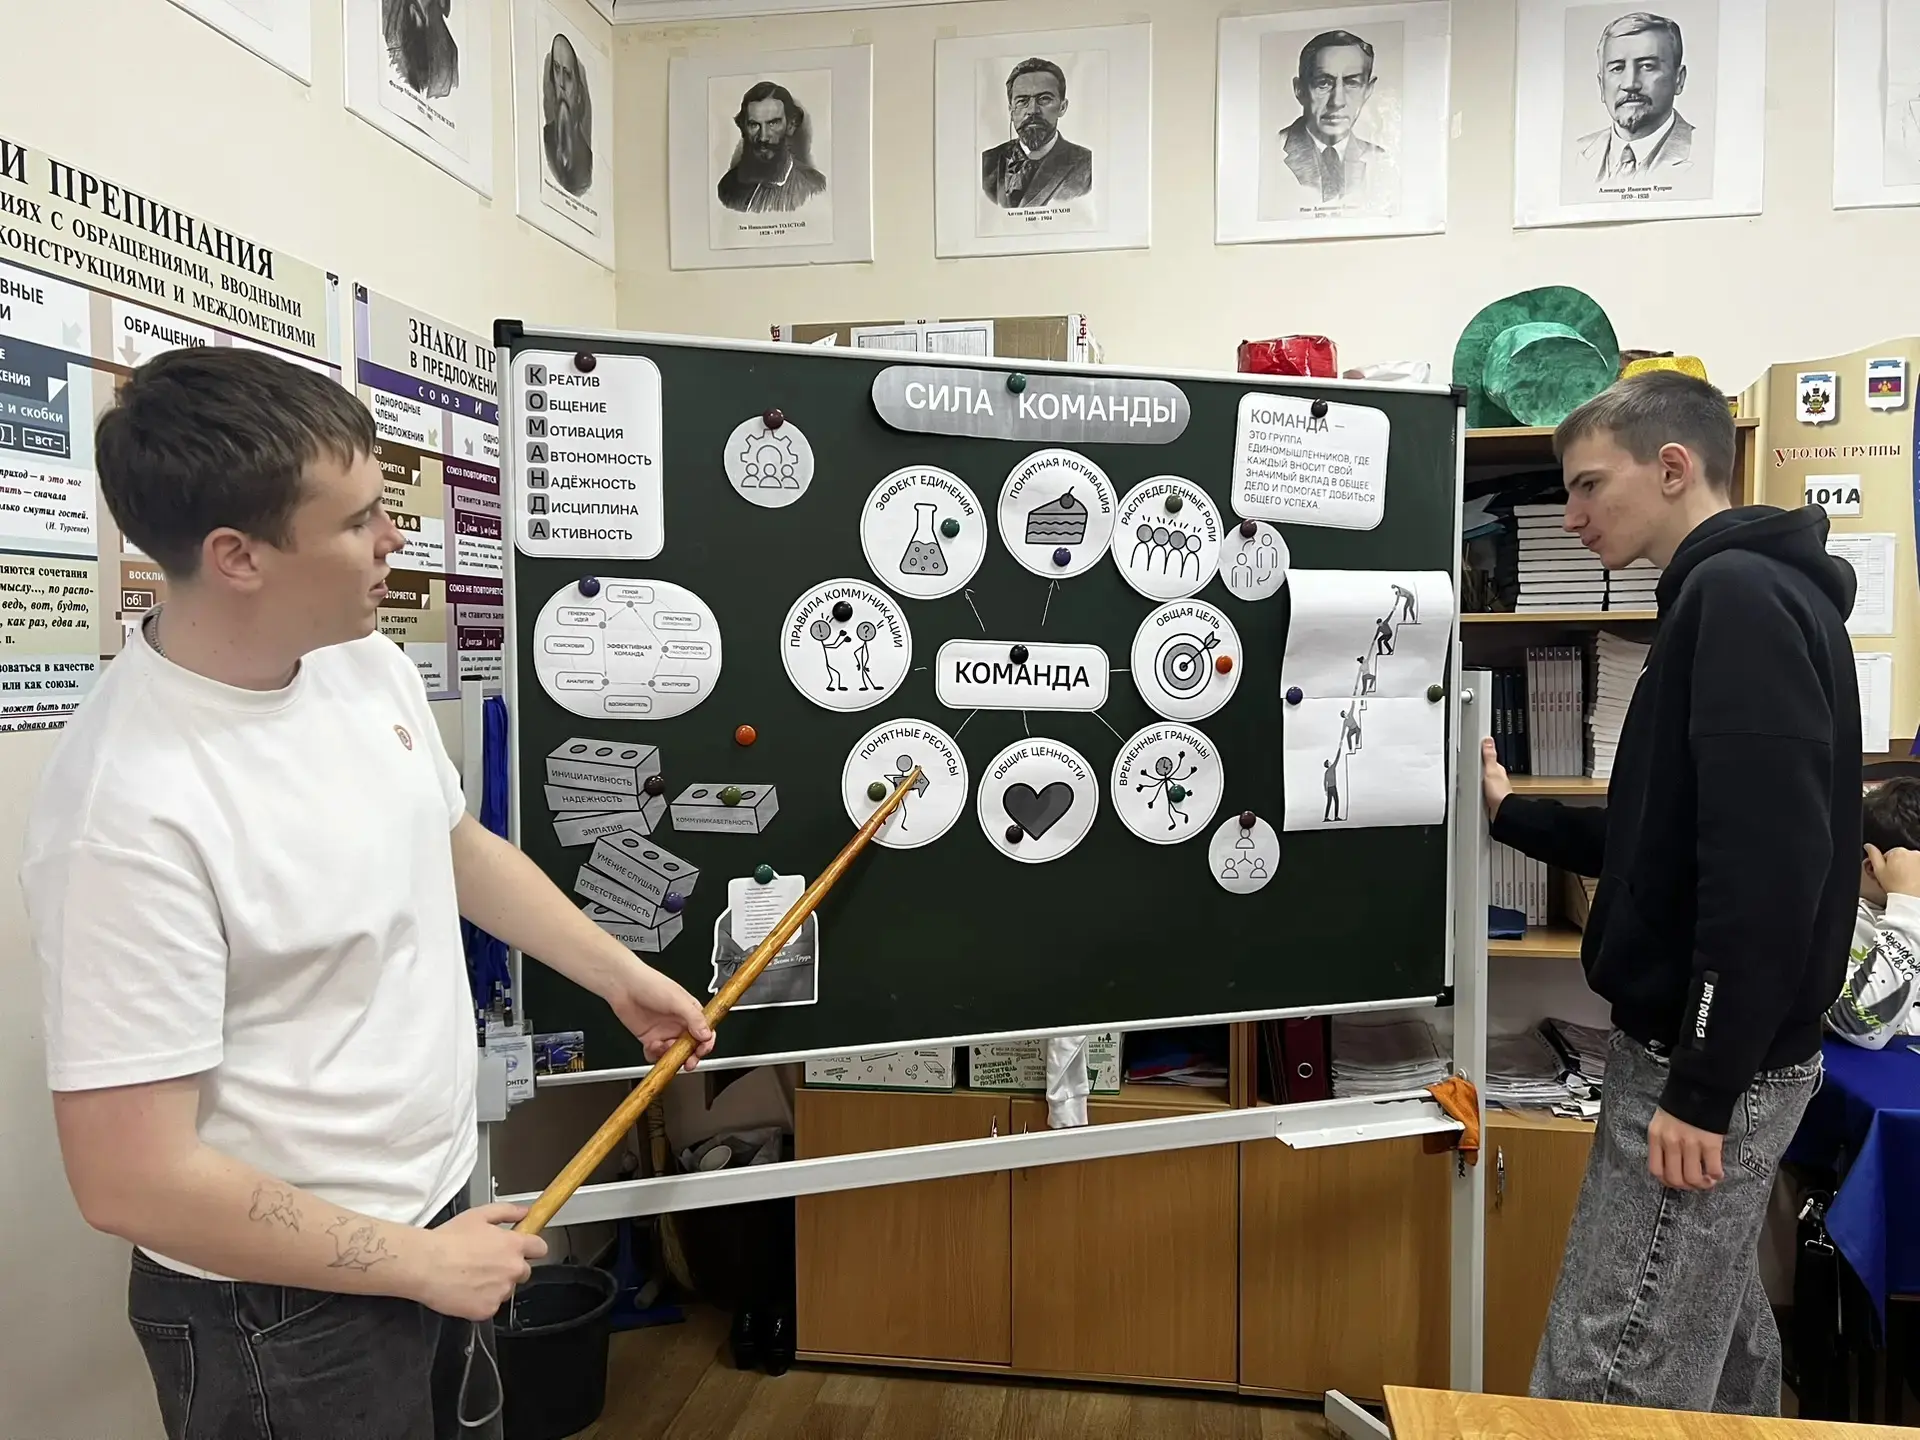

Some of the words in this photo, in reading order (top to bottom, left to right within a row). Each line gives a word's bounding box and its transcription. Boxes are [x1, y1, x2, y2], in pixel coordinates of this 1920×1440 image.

[0, 138, 28, 185] И
[47, 158, 274, 281] ПРЕПИНАНИЯ
[51, 211, 64, 230] С
[72, 218, 214, 289] ОБРАЩЕНИЯМИ,
[221, 273, 302, 318] ВВОДНЫМИ
[173, 284, 185, 304] И
[192, 291, 316, 348] МЕЖДОМЕТИЯМИ
[124, 315, 206, 347] ОБРАЩЕНИЯ
[409, 317, 468, 363] ЗНАКИ
[475, 344, 496, 373] ПР
[410, 350, 417, 368] В
[423, 355, 498, 397] ПРЕДЛОЖЕНИ
[375, 393, 421, 416] ОДНОРОДНЫЕ
[904, 381, 994, 416] СИЛА
[1019, 392, 1177, 428] КОМАНДЫ
[8, 404, 16, 414] и
[20, 406, 64, 424] скобки
[375, 408, 399, 422] ЧЛЕНЫ
[1250, 408, 1329, 434] КОМАНДА
[375, 421, 425, 443] ПРЕДЛОЖЕНИЯ
[1248, 430, 1267, 441] ЭТО
[1268, 432, 1302, 445] ГРУППА
[1248, 442, 1352, 465] ЕДИНОМЫШЛЕННИКОВ,
[1354, 456, 1371, 466] ГДЕ
[1843, 445, 1901, 458] ГРУППЫ
[446, 465, 462, 475] СОЮЗ
[463, 469, 497, 484] ПОВТОРЯЕТСЯ
[1247, 455, 1288, 469] КАЖДЫЙ
[1290, 460, 1326, 473] ВНОСИТ
[1328, 464, 1353, 476] СВОЙ
[47, 476, 64, 484] это
[1009, 457, 1060, 500] ПОНЯТНАЯ
[1062, 458, 1110, 514] МОТИВАЦИЯ
[1246, 467, 1297, 481] ЗНАЧИМЫЙ
[1299, 474, 1329, 487] ВКЛАД
[1331, 478, 1337, 486] В
[1339, 478, 1369, 490] ОБЩЕЕ
[33, 490, 66, 501] сначала
[457, 494, 481, 505] ставится
[875, 475, 918, 511] ЭФФЕКТ
[920, 474, 974, 517] ЕДИНЕНИЯ
[1244, 480, 1269, 492] ДЕЛО
[1272, 483, 1278, 492] И
[1280, 484, 1326, 497] ПОМОГАЕТ
[1328, 489, 1376, 503] ДОБИТЬСЯ
[1244, 494, 1281, 505] ОБЩЕГО
[1284, 497, 1320, 509] УСПЕХА.
[0, 503, 20, 512] лько
[23, 505, 55, 516] смутил
[58, 510, 89, 520] гостей.
[1121, 484, 1206, 526] РАСПРЕДЕЛЕННЫЕ
[1202, 510, 1216, 542] РОЛИ
[38, 567, 88, 579] сочетания
[48, 585, 60, 594] по
[62, 586, 94, 596] распо-
[449, 584, 464, 592] СОЮЗ
[466, 585, 472, 593] НЕ
[2, 598, 27, 611] ведь,
[31, 602, 53, 612] вот,
[57, 600, 89, 613] будто,
[126, 594, 142, 606] об!
[7, 618, 25, 626] как
[28, 618, 48, 629] раз,
[51, 616, 72, 627] едва
[75, 620, 90, 629] ли,
[381, 615, 389, 623] не
[391, 616, 418, 624] ставится
[791, 596, 824, 648] ПРАВИЛА
[824, 588, 903, 648] КОММУНИКАЦИИ
[1156, 607, 1194, 628] ОБЩАЯ
[1195, 608, 1221, 630] ЦЕЛЬ
[381, 627, 406, 635] запятая
[607, 643, 652, 651] ЭФФЕКТИВНАЯ
[614, 650, 645, 658] КОМАНДА
[44, 664, 50, 672] в
[53, 663, 94, 672] качестве
[955, 661, 1090, 691] КОМАНДА
[2, 681, 20, 690] или
[25, 681, 42, 689] как
[45, 680, 79, 689] союзы.
[2, 704, 34, 713] может
[36, 702, 59, 711] быть
[17, 720, 46, 730] однако
[860, 726, 920, 760] ПОНЯТНЫЕ
[922, 731, 959, 777] РЕСУРСЫ
[1119, 731, 1163, 786] ВРЕМЕННЫЕ
[1164, 730, 1211, 760] ГРАНИЦЫ
[993, 748, 1029, 781] ОБЩИЕ
[1031, 746, 1086, 781] ЦЕННОСТИ
[551, 769, 633, 787] ИНИЦИАТИВНОСТЬ
[562, 795, 623, 804] НАДЕЖНОСТЬ
[582, 823, 624, 837] ЭМПАТИЯ
[676, 816, 754, 826] КОММУНИКАБЕЛЬНОСТЬ
[596, 852, 627, 875] УМЕНИЕ
[627, 870, 661, 896] СЛУШАТЬ
[579, 879, 651, 919] ОТВЕТСТВЕННОСТЬ
[612, 934, 645, 944] ЛЮБИЕ
